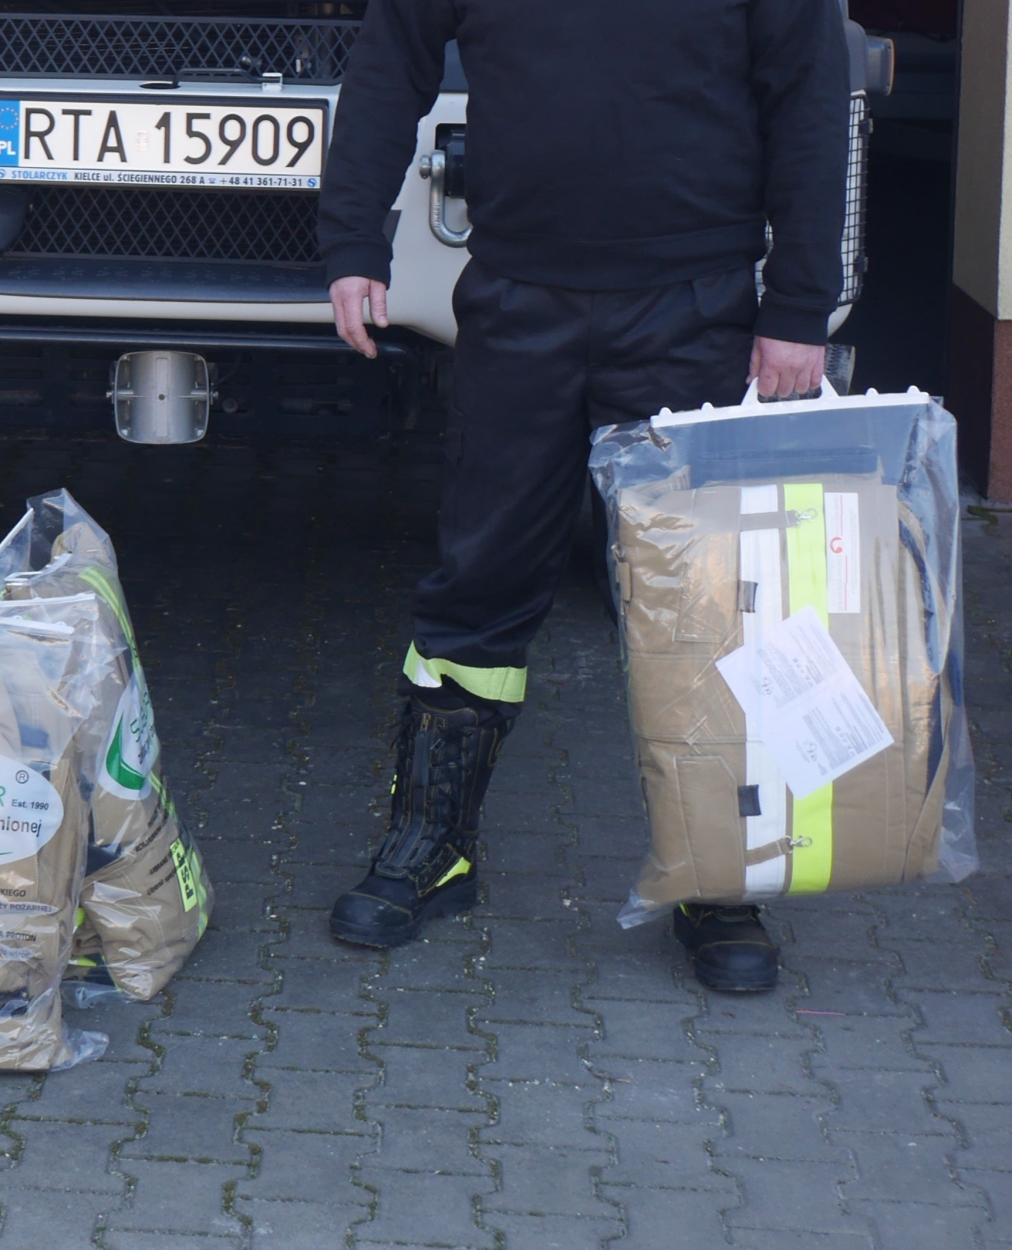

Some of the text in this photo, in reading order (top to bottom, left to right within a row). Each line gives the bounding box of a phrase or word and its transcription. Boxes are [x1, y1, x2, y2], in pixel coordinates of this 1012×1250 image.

[23, 107, 316, 169] RTA 15909
[11, 170, 68, 181] STOLARCZYK
[74, 172, 101, 182] KIELCE
[104, 173, 115, 182] ul.
[117, 172, 177, 184] ŚCIEGIENNEGO
[180, 175, 197, 185] 268
[199, 176, 206, 185] A
[243, 176, 254, 186] 41
[257, 177, 303, 187] 361-71-31
[11, 798, 50, 811] Est. 1990
